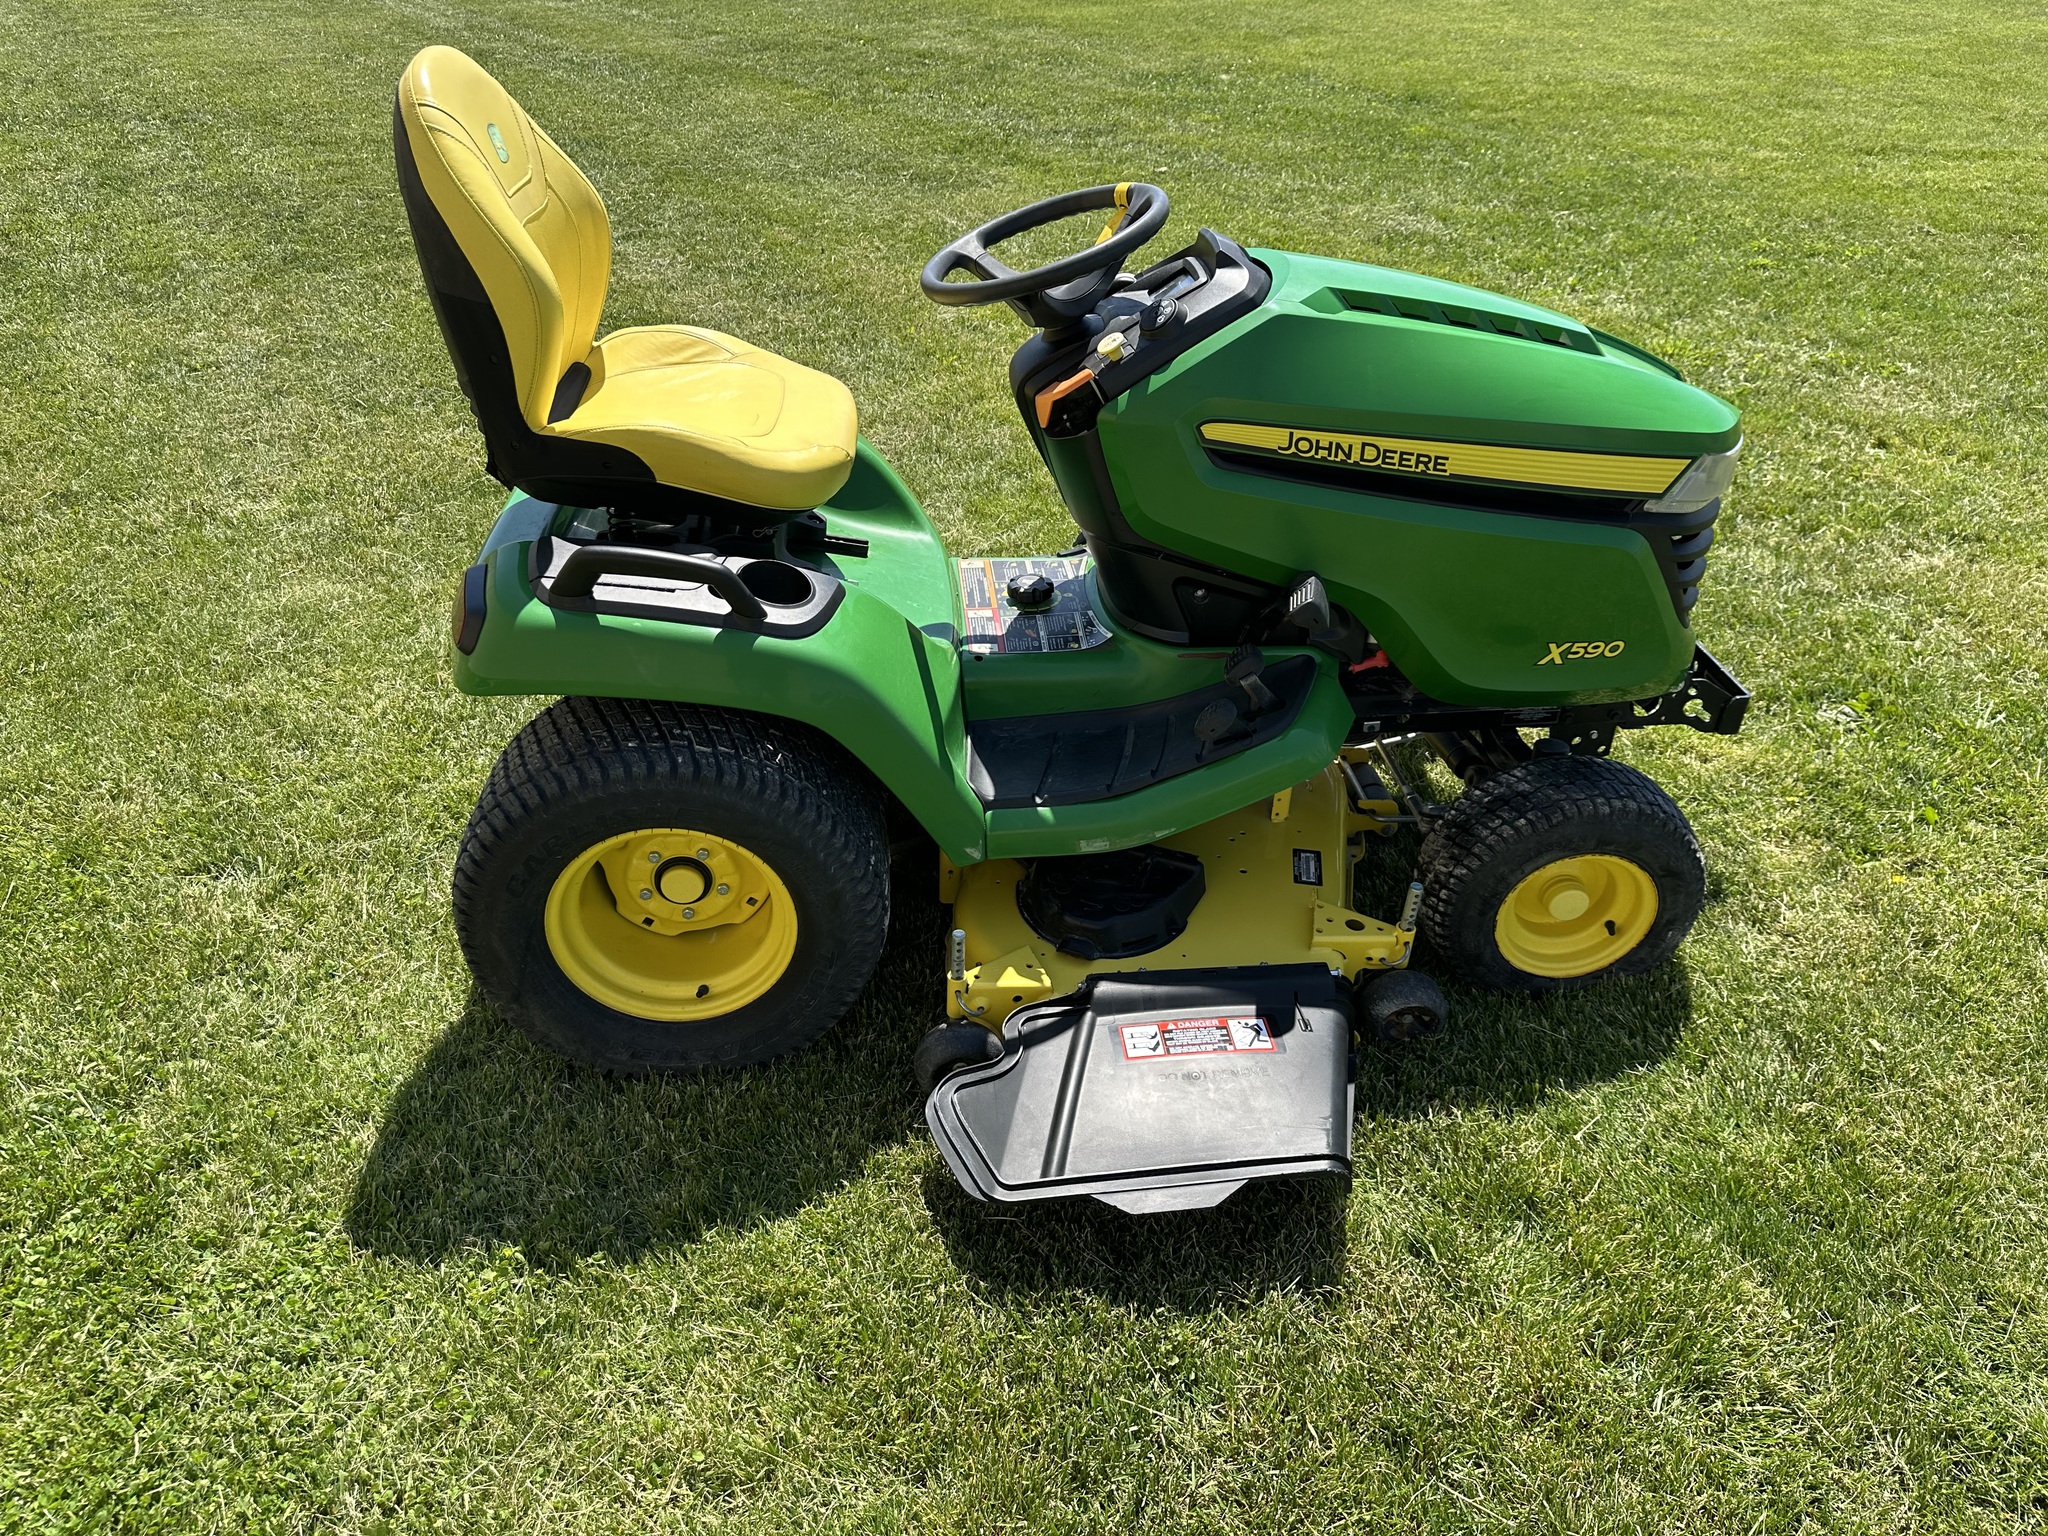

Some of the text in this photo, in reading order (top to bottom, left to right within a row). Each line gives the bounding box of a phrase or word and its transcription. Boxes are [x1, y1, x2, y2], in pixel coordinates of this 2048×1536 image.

[1359, 442, 1449, 474] DEERE
[1536, 640, 1625, 665] X590
[1177, 1019, 1220, 1029] DANGER
